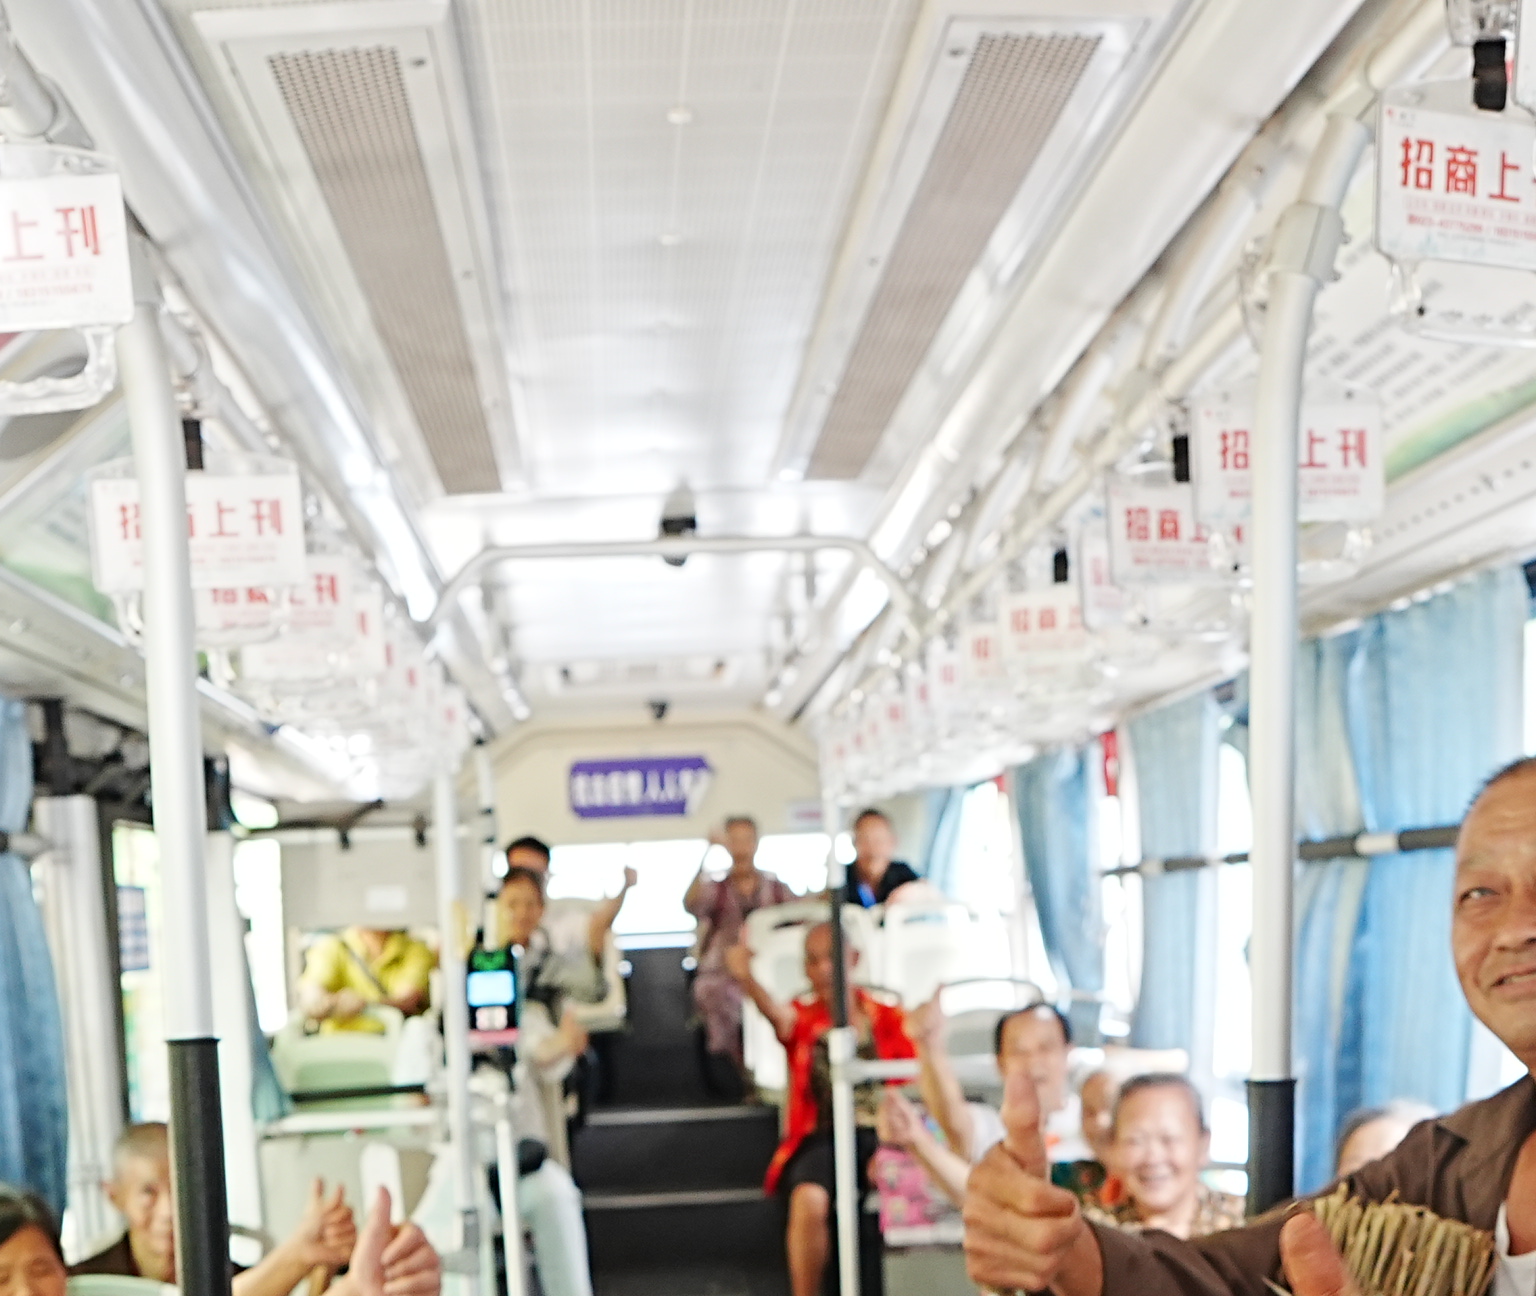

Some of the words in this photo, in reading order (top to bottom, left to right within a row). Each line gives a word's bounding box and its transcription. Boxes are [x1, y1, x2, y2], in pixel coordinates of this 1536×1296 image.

[1220, 428, 1368, 470] 招上刊
[119, 497, 284, 540] 招上刊
